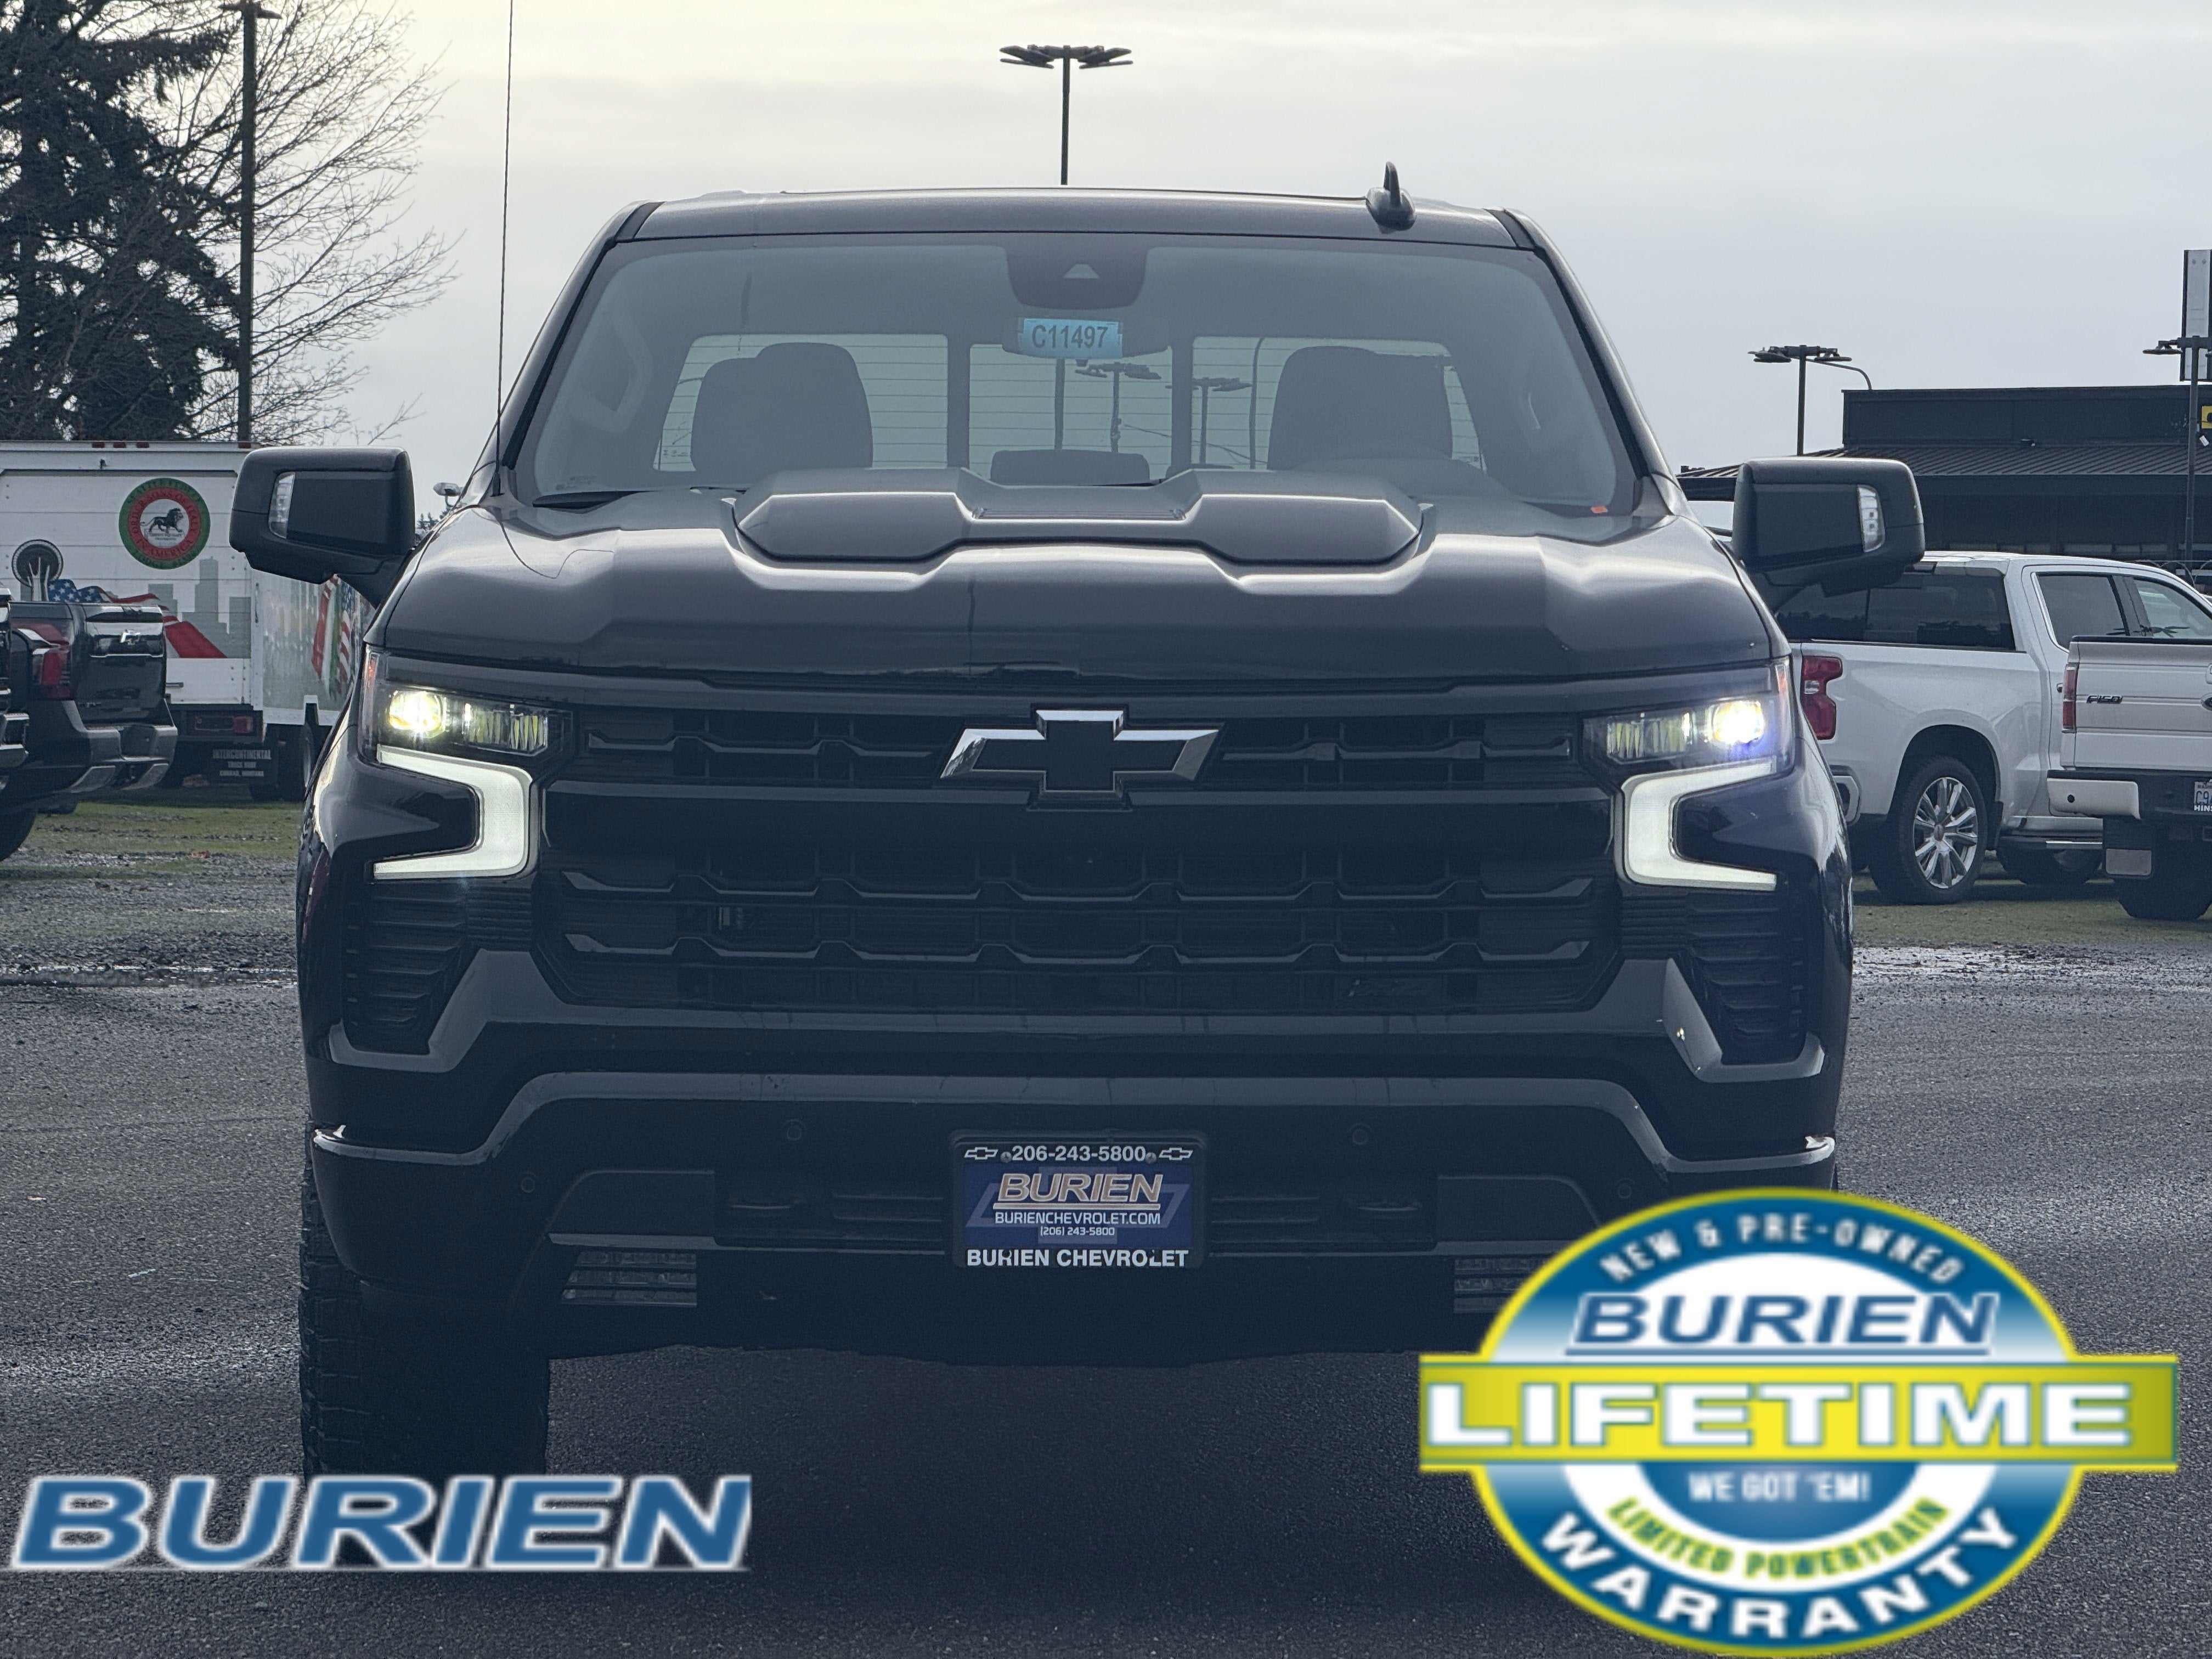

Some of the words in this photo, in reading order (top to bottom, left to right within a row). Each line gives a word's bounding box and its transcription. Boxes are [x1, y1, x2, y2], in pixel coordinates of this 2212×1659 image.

[1031, 325, 1109, 348] C11497
[2196, 791, 2212, 805] C9
[1012, 1146, 1147, 1162] 206-243-5800
[997, 1173, 1164, 1203] BURIEN
[995, 1211, 1161, 1225] BURIENCHEVROLET.COM
[1040, 1227, 1065, 1237] (206)
[1067, 1227, 1115, 1237] 243-5800
[967, 1249, 1050, 1267] BURIEN
[1057, 1249, 1189, 1267] CHEVROLET
